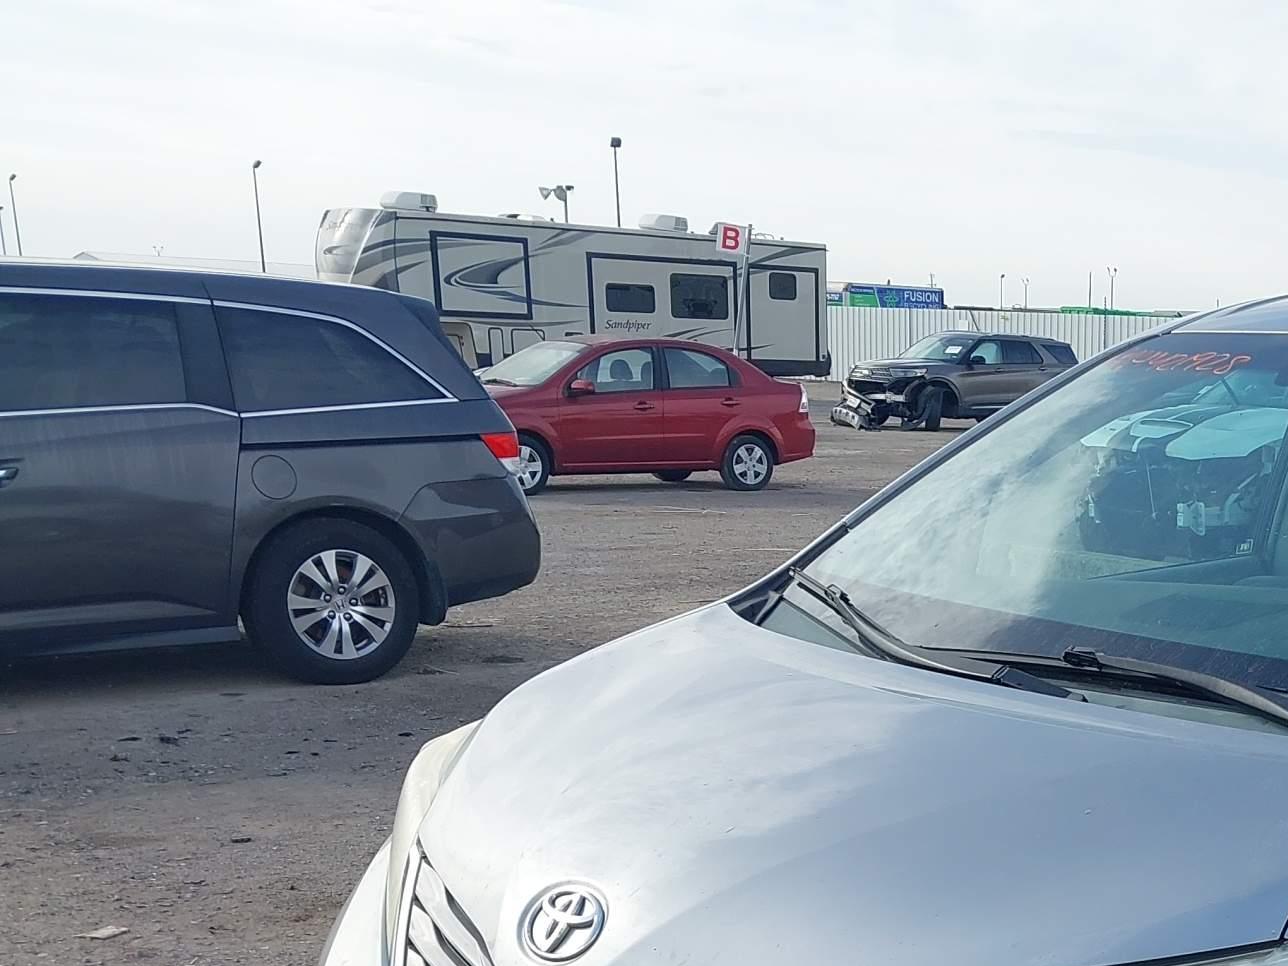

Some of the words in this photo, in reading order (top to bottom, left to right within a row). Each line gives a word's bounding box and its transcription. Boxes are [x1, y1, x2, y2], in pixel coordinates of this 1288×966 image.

[721, 225, 740, 250] B
[903, 291, 940, 303] FUSION
[604, 319, 652, 332] Sandpiper
